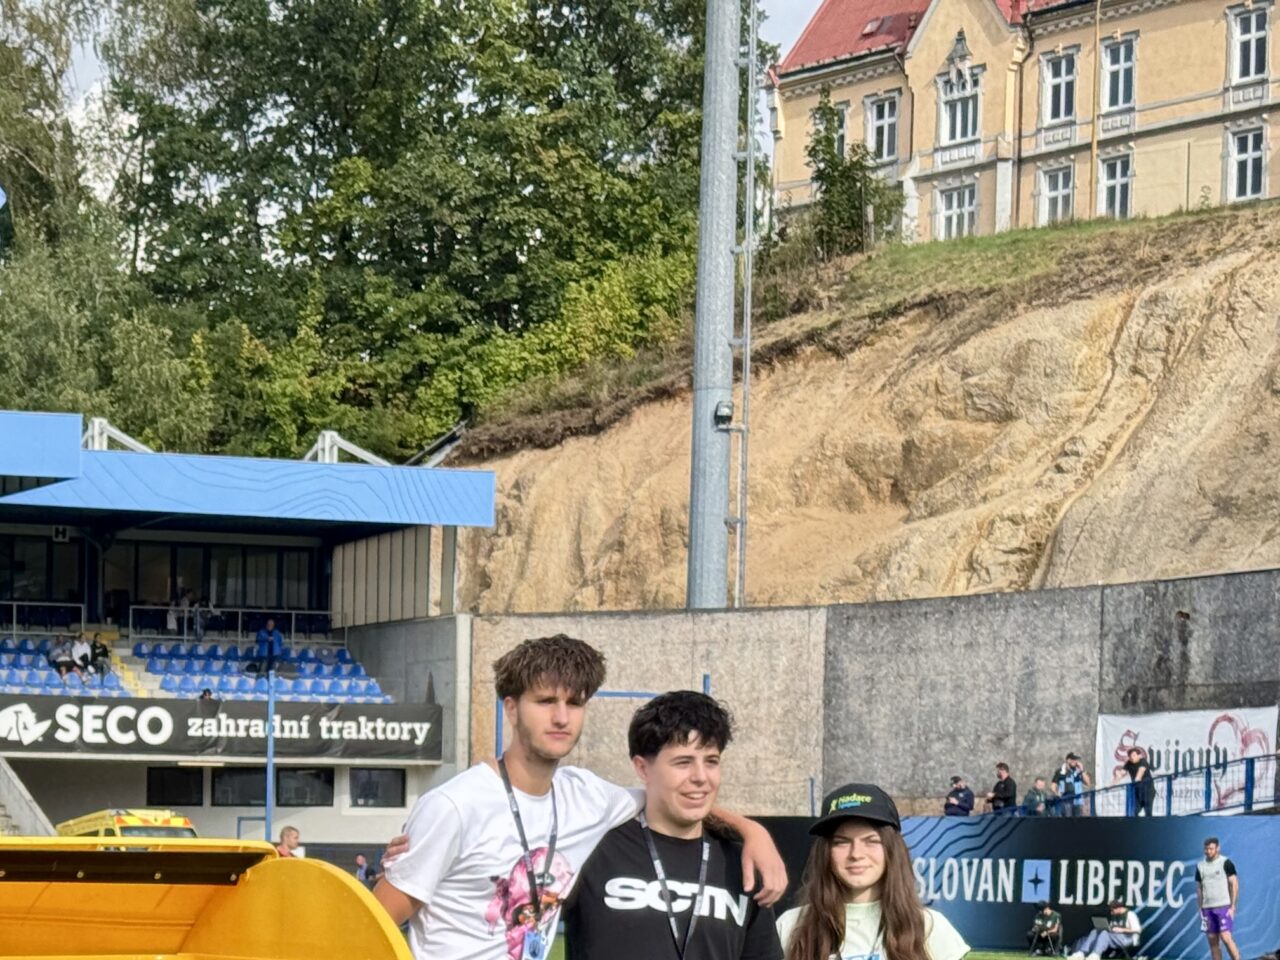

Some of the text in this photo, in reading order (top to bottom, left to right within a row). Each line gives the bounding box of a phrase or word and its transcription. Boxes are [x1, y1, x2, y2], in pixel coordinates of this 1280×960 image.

[54, 527, 67, 539] H
[54, 702, 431, 746] SECO zahradní traktory
[912, 857, 1186, 909] SLOVAN LIBEREC
